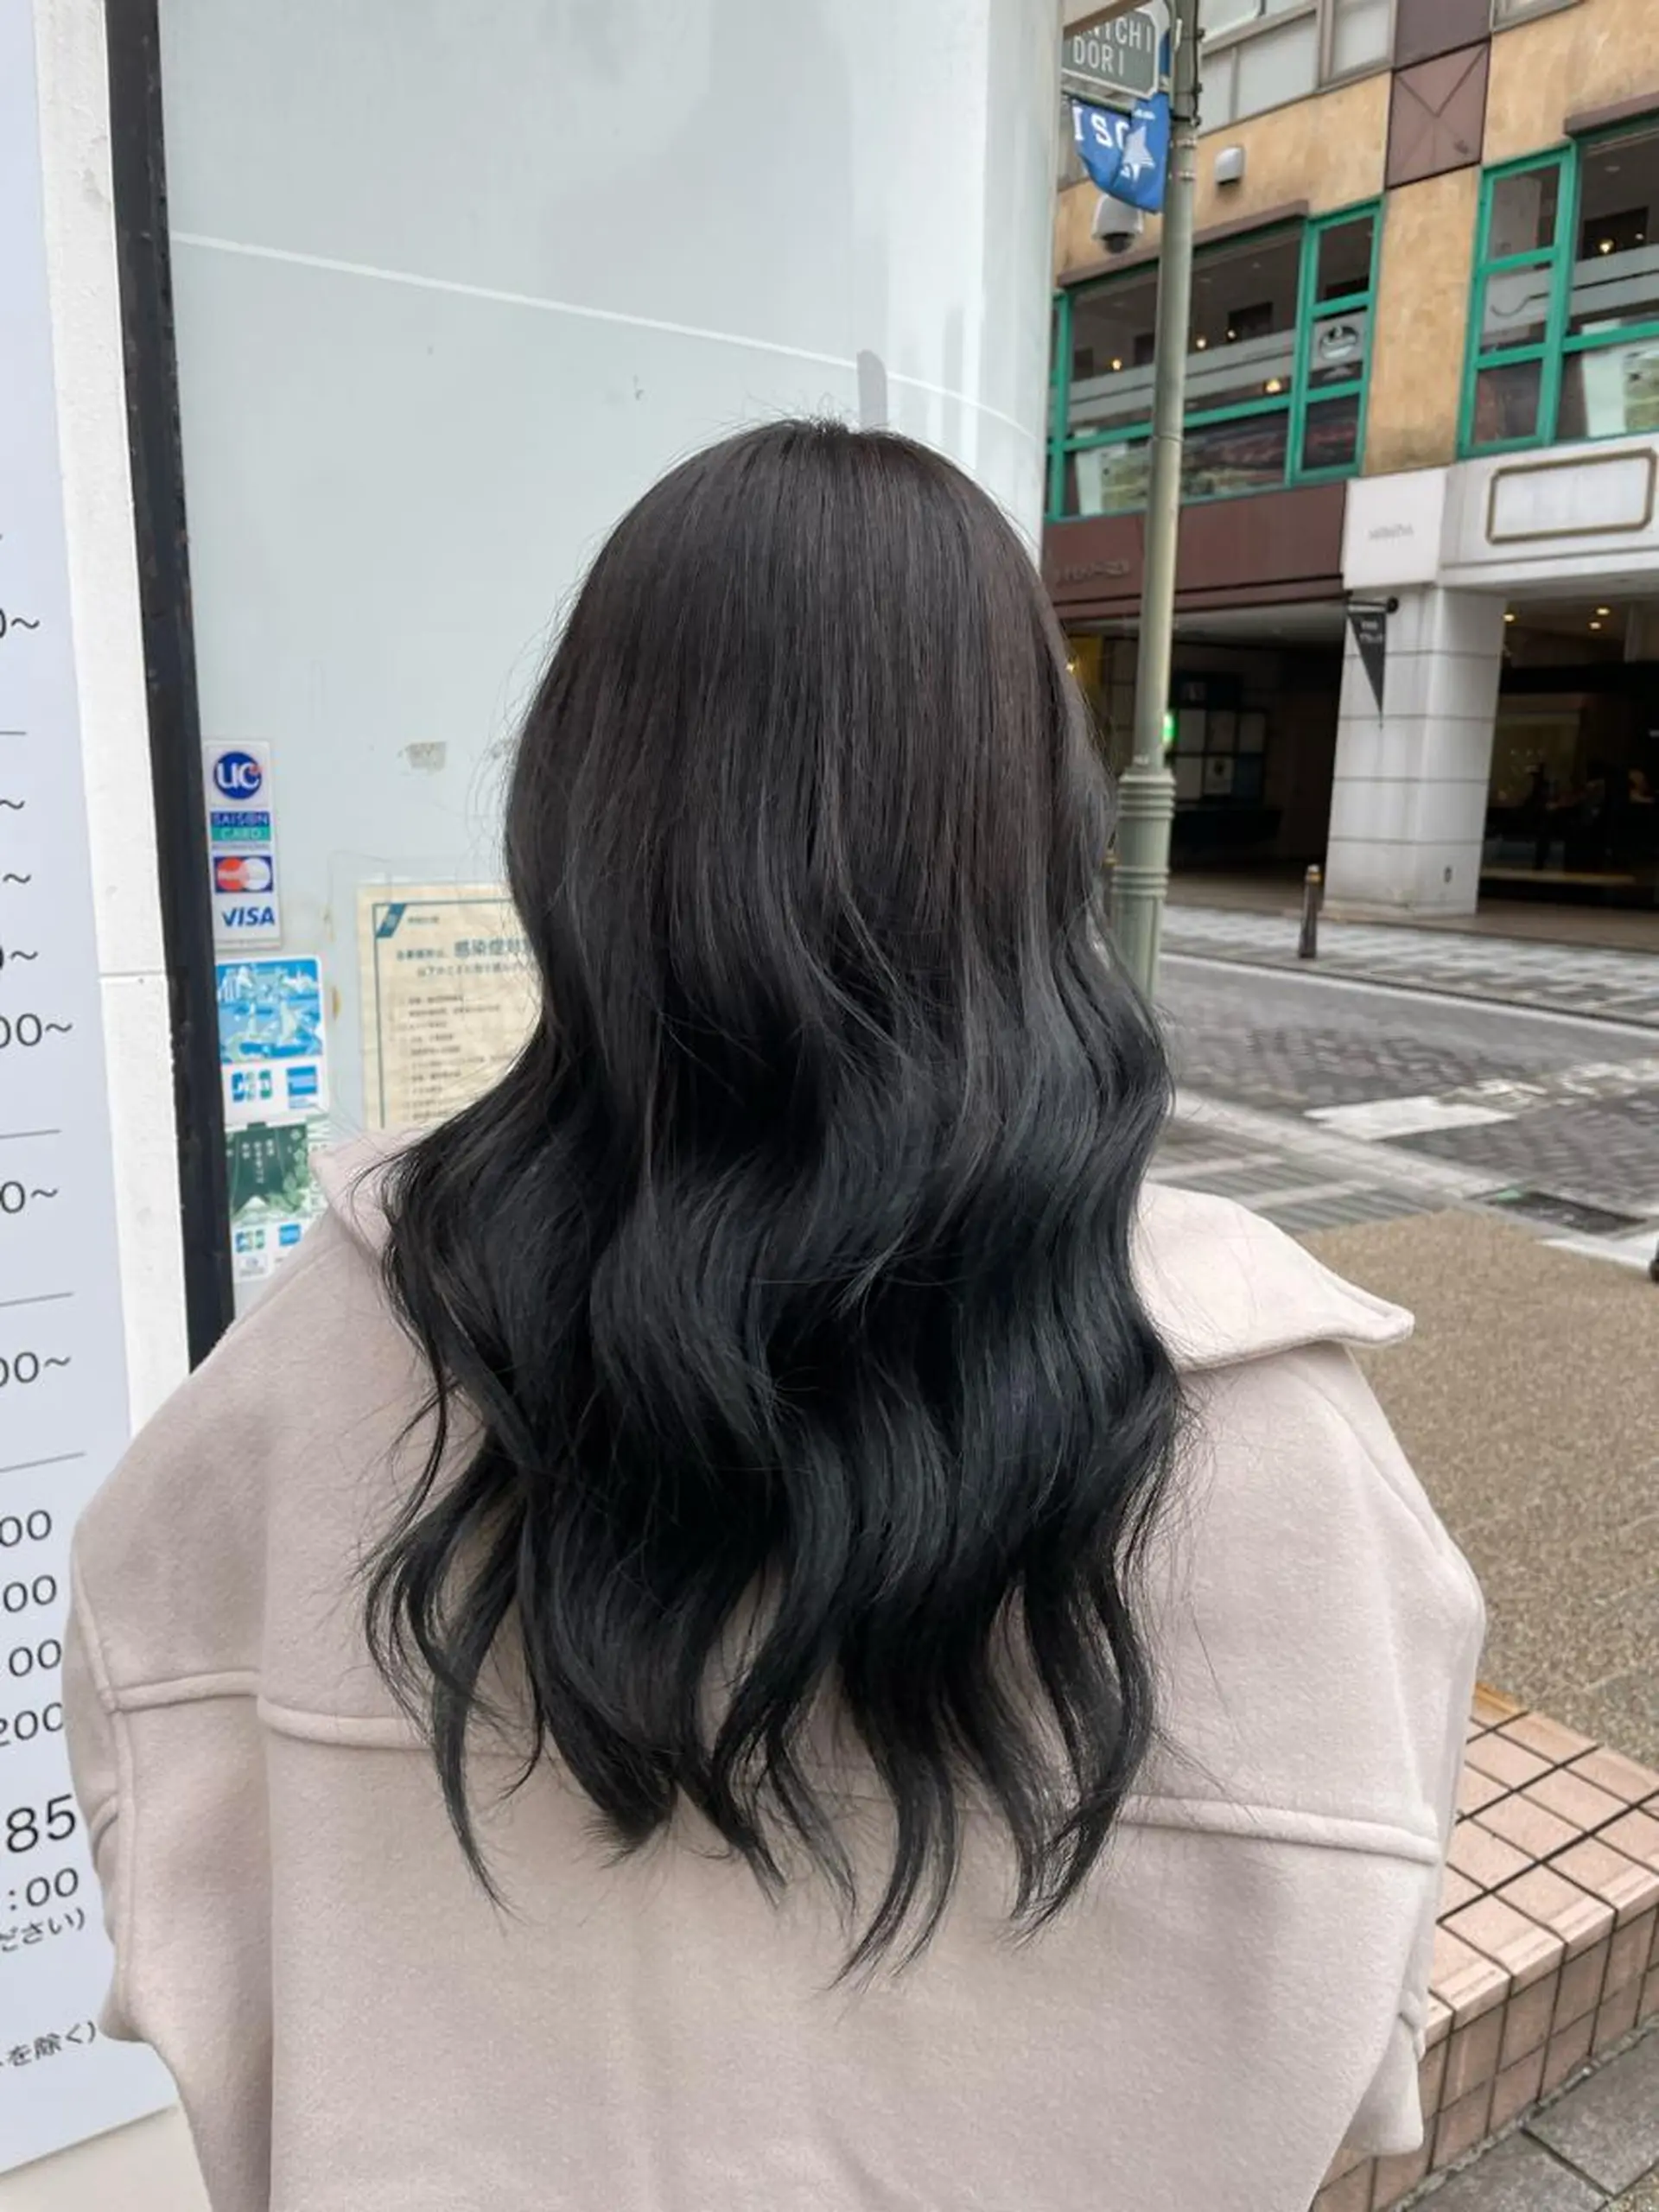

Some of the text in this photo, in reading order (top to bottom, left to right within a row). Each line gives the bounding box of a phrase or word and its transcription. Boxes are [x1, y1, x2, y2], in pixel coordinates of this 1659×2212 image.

[1073, 35, 1123, 77] DORI
[217, 763, 260, 789] UC
[222, 907, 275, 927] VISA
[3, 1575, 57, 1612] 00
[9, 1639, 62, 1677] 00
[6, 1794, 75, 1853] 85
